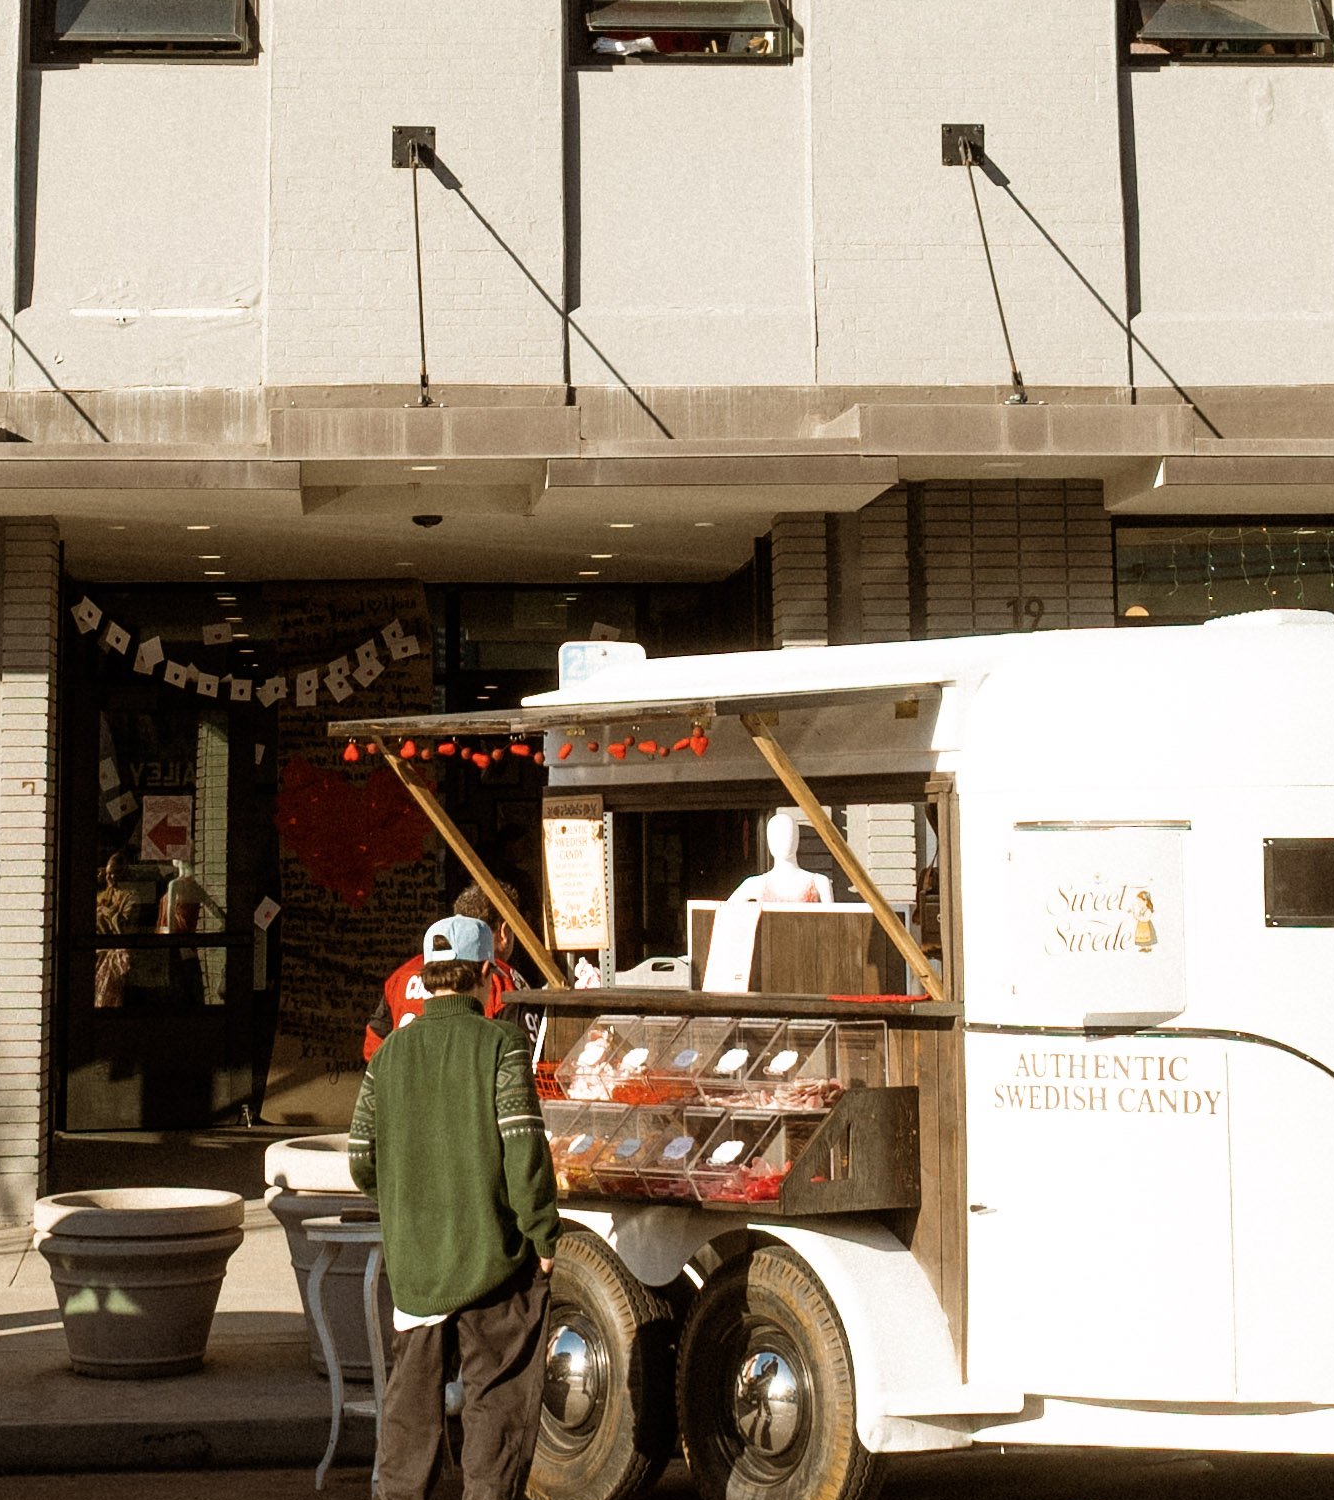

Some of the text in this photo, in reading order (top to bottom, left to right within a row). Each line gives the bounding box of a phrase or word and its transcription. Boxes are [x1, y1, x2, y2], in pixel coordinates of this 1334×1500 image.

[1006, 596, 1045, 630] 19
[555, 825, 588, 835] AUENTIC
[1046, 882, 1133, 916] Sweet
[1043, 919, 1134, 957] Swede
[1014, 1052, 1189, 1082] AUTHENTIC
[993, 1084, 1223, 1116] SWEDISH CANDY
